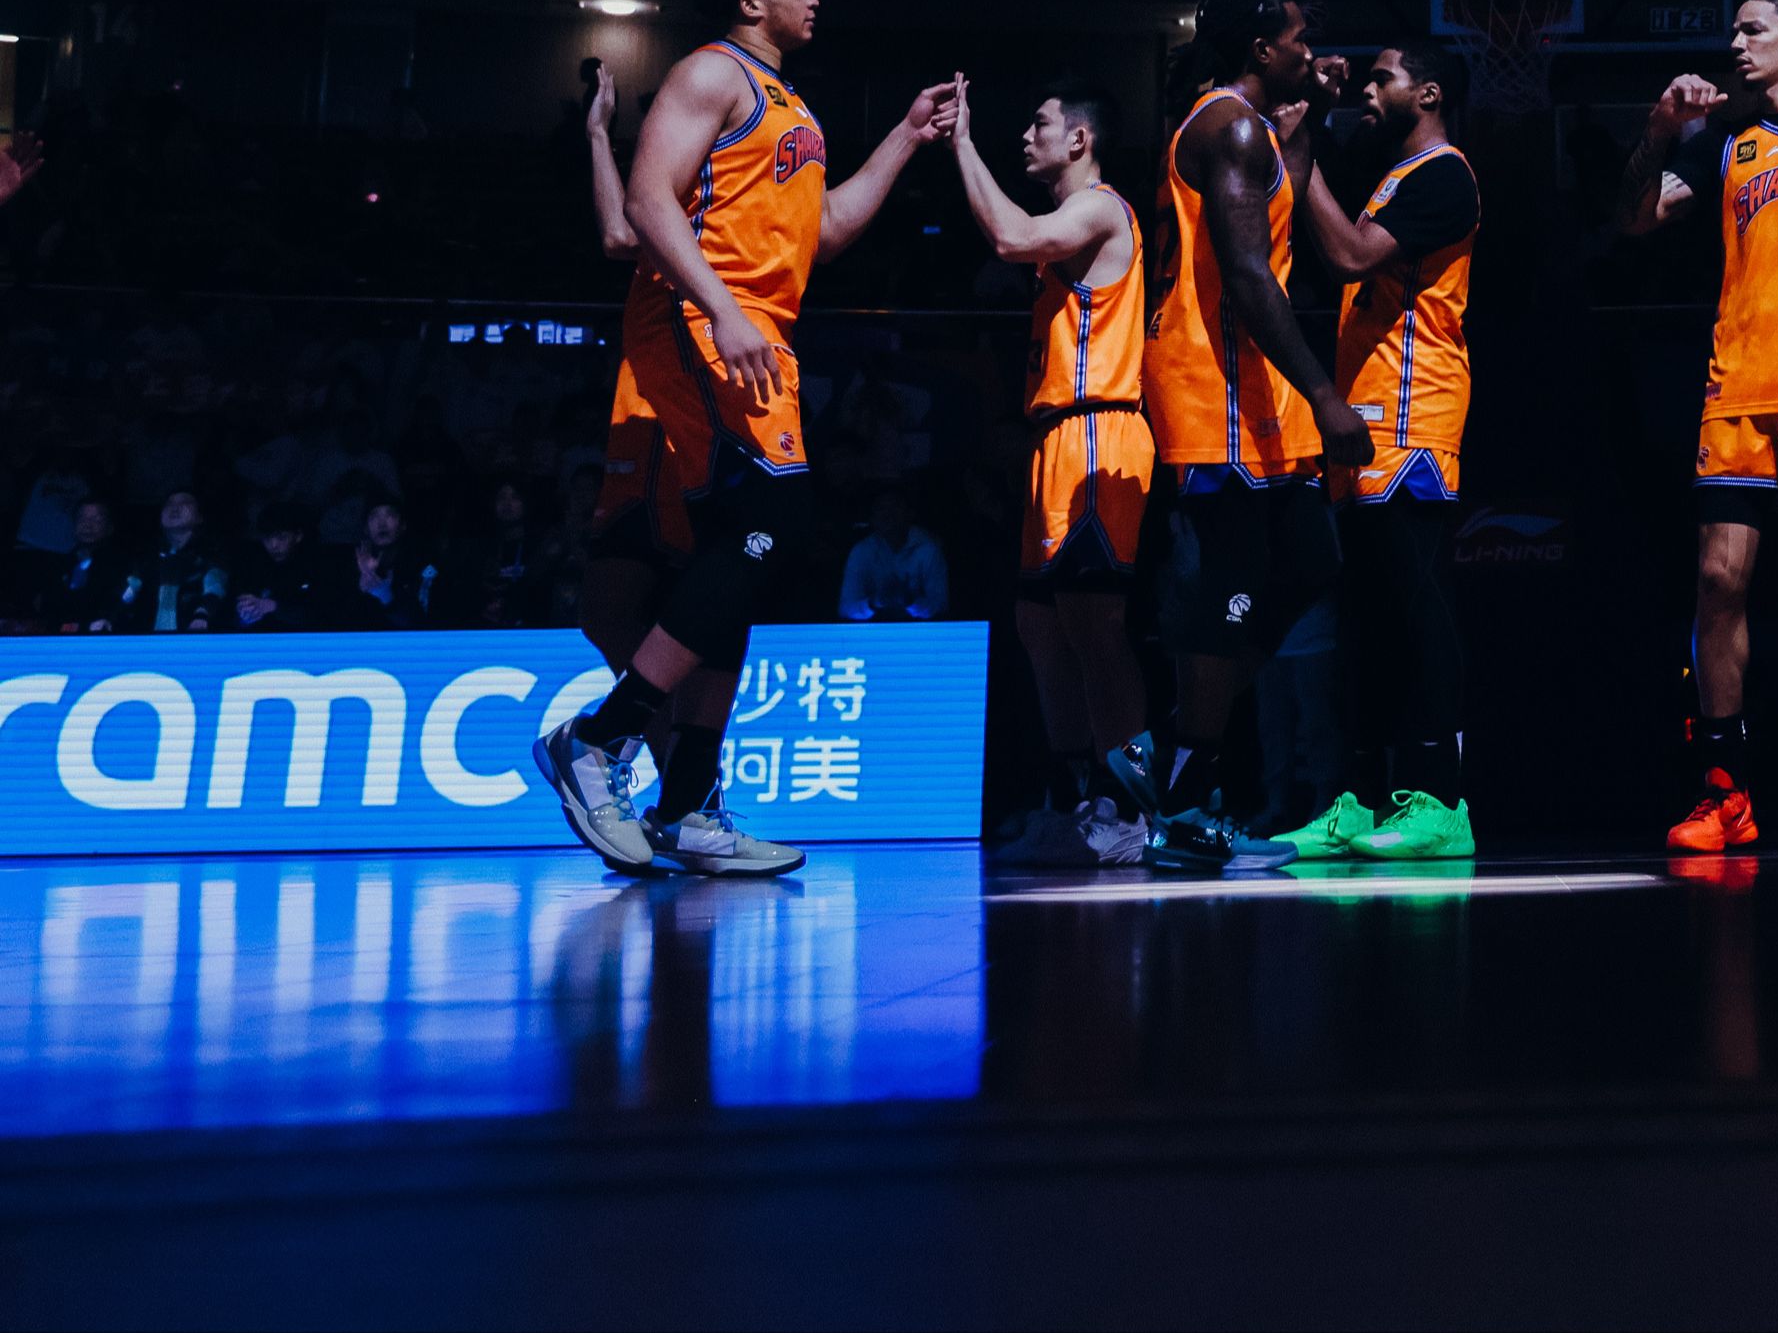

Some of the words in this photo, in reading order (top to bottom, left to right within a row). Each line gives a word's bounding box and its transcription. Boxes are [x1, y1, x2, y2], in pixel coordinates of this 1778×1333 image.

[1454, 543, 1567, 564] LI-NING
[732, 657, 867, 724] 沙特
[720, 734, 861, 803] 阿美
